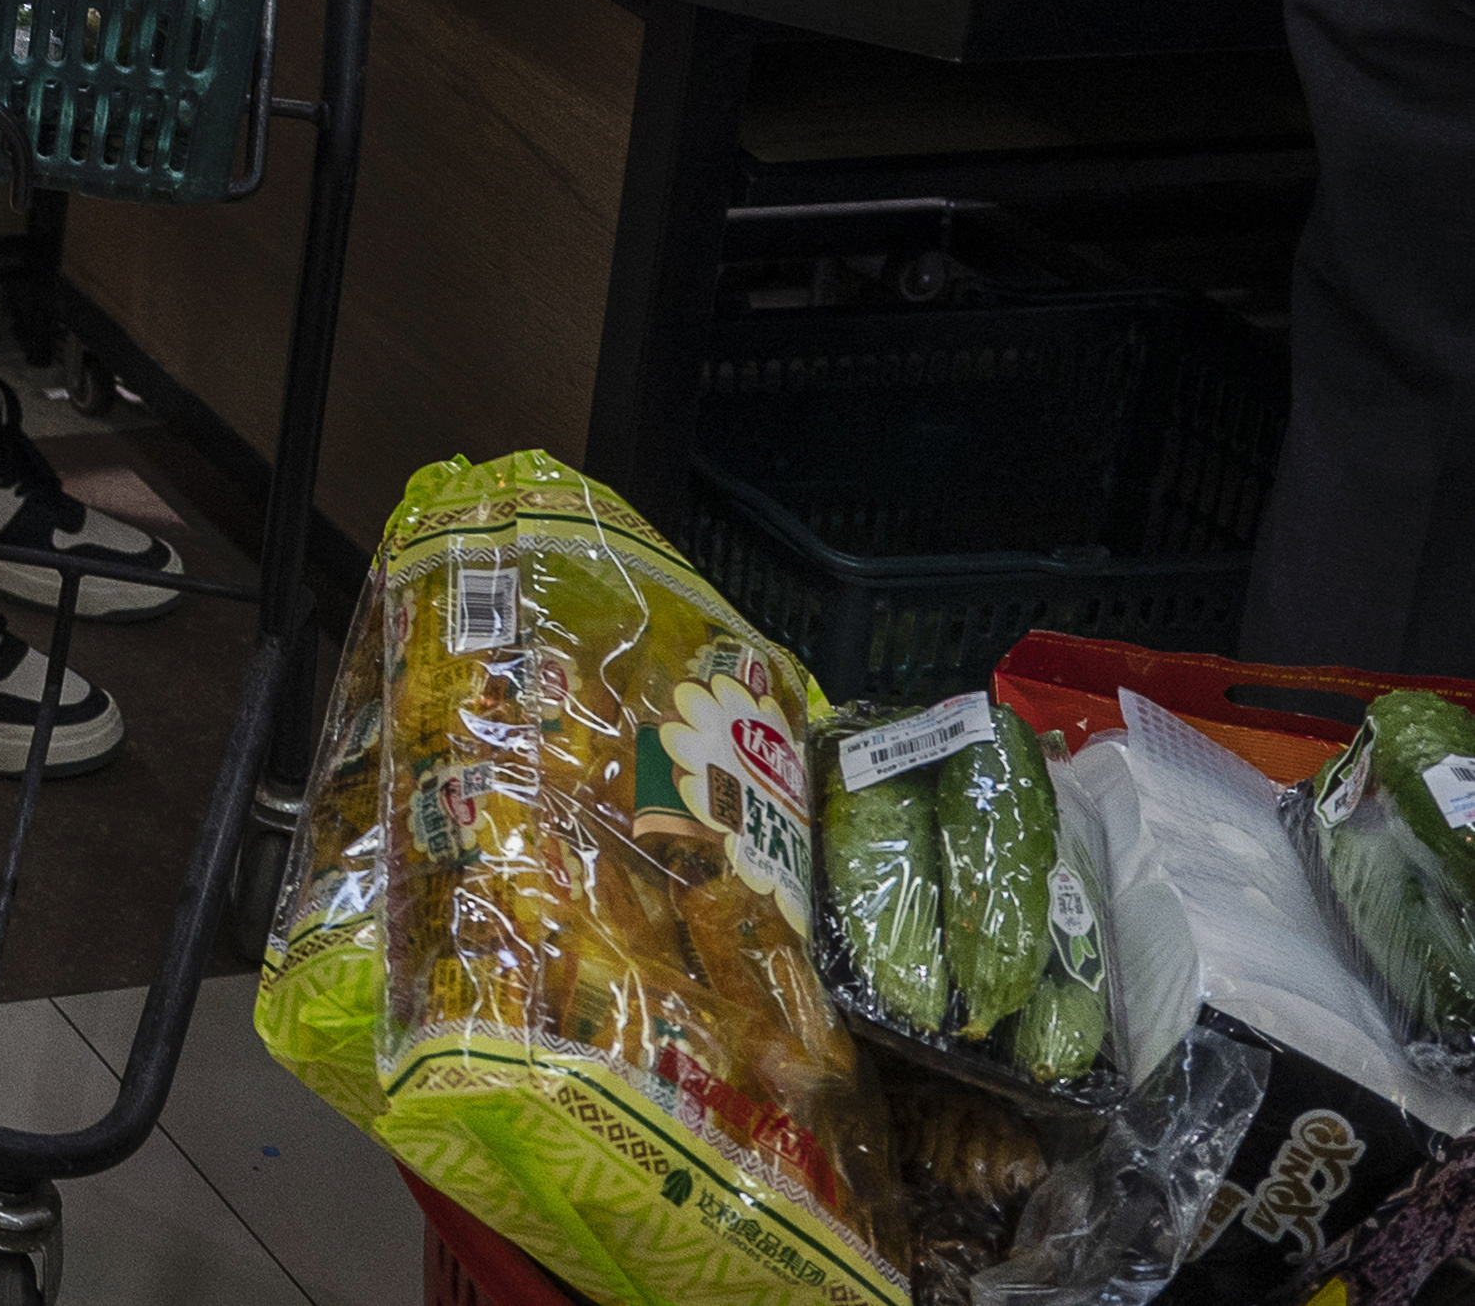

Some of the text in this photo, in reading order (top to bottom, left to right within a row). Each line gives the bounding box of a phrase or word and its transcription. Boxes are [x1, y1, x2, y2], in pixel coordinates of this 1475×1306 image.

[696, 1188, 826, 1285] 达利食品集团
